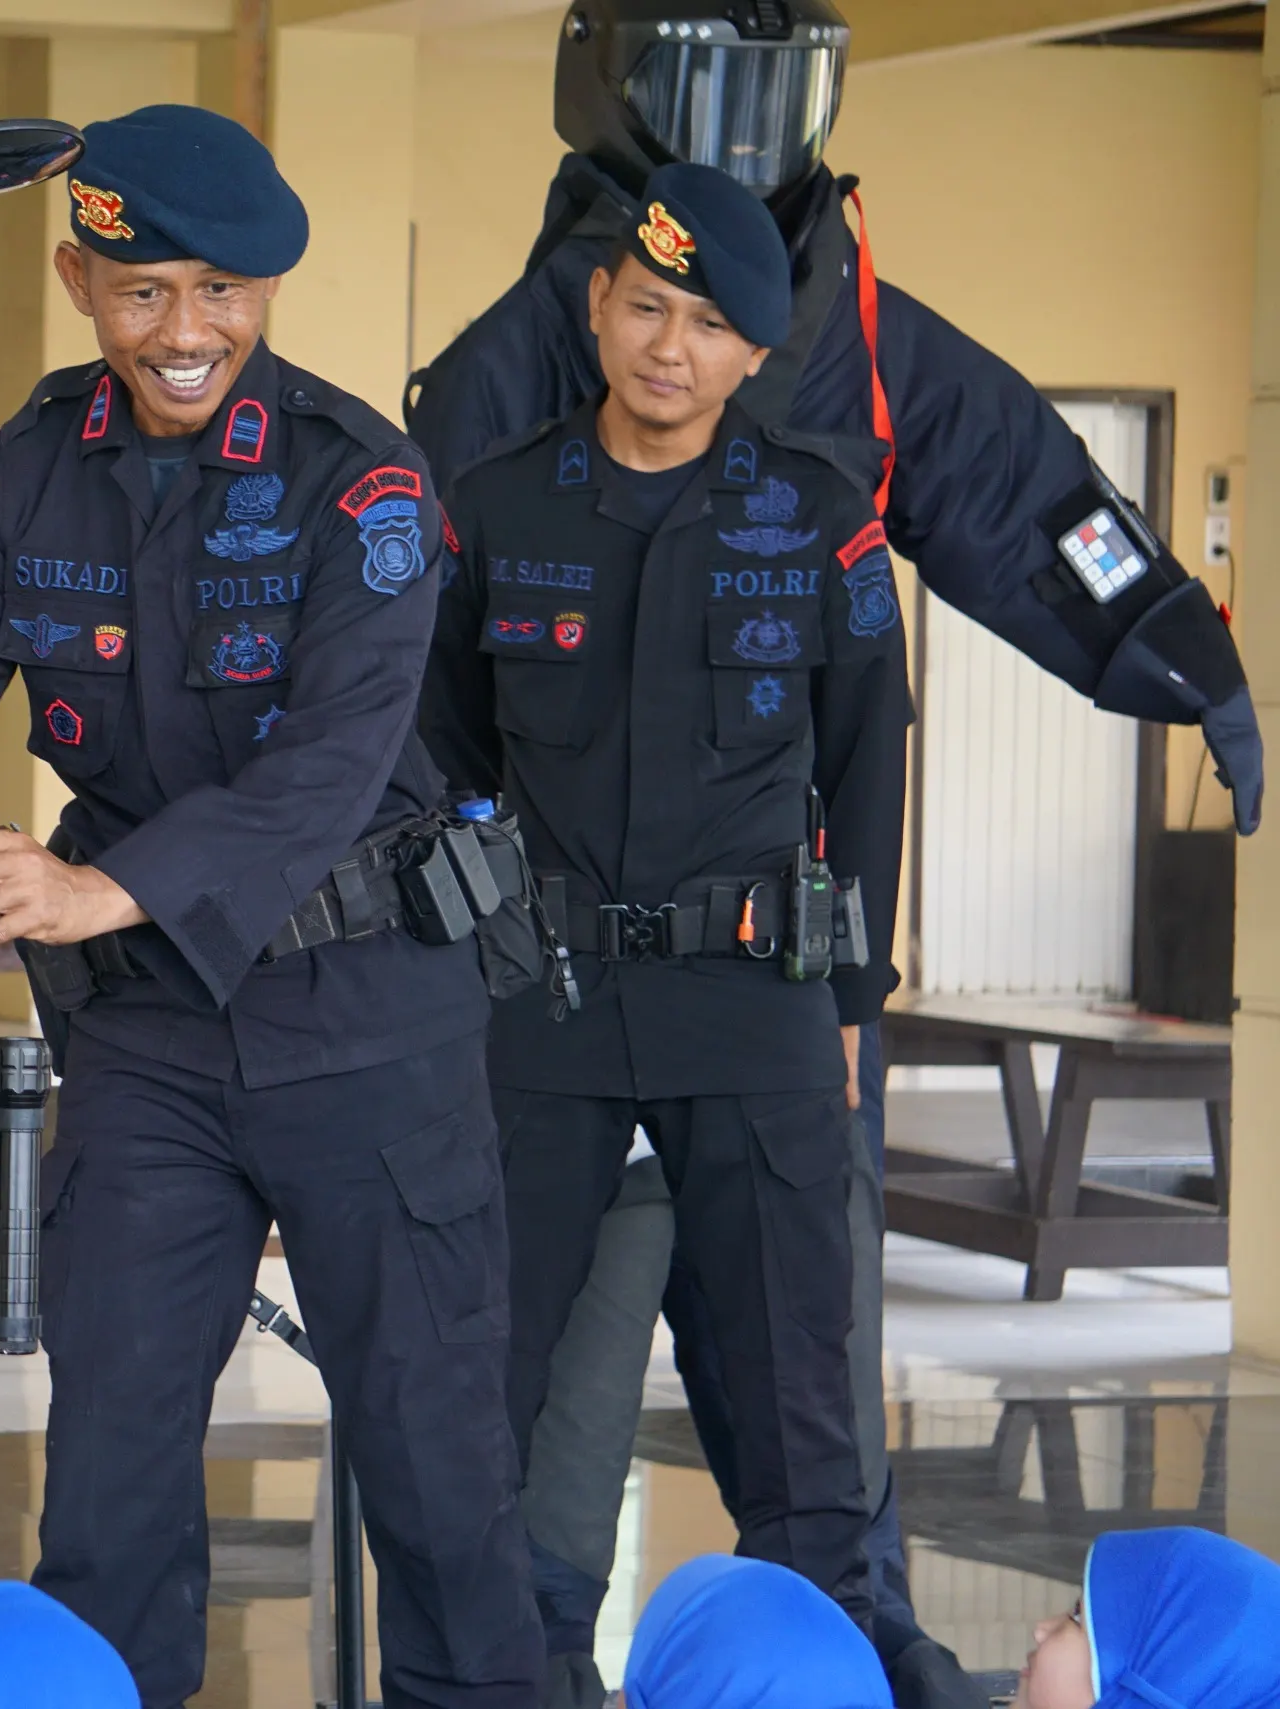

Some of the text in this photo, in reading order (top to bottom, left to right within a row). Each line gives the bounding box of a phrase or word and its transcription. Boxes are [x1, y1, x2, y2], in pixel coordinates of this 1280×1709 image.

[15, 555, 128, 597] SUKADI
[195, 572, 303, 610] POLRI
[709, 569, 821, 597] POLRI
